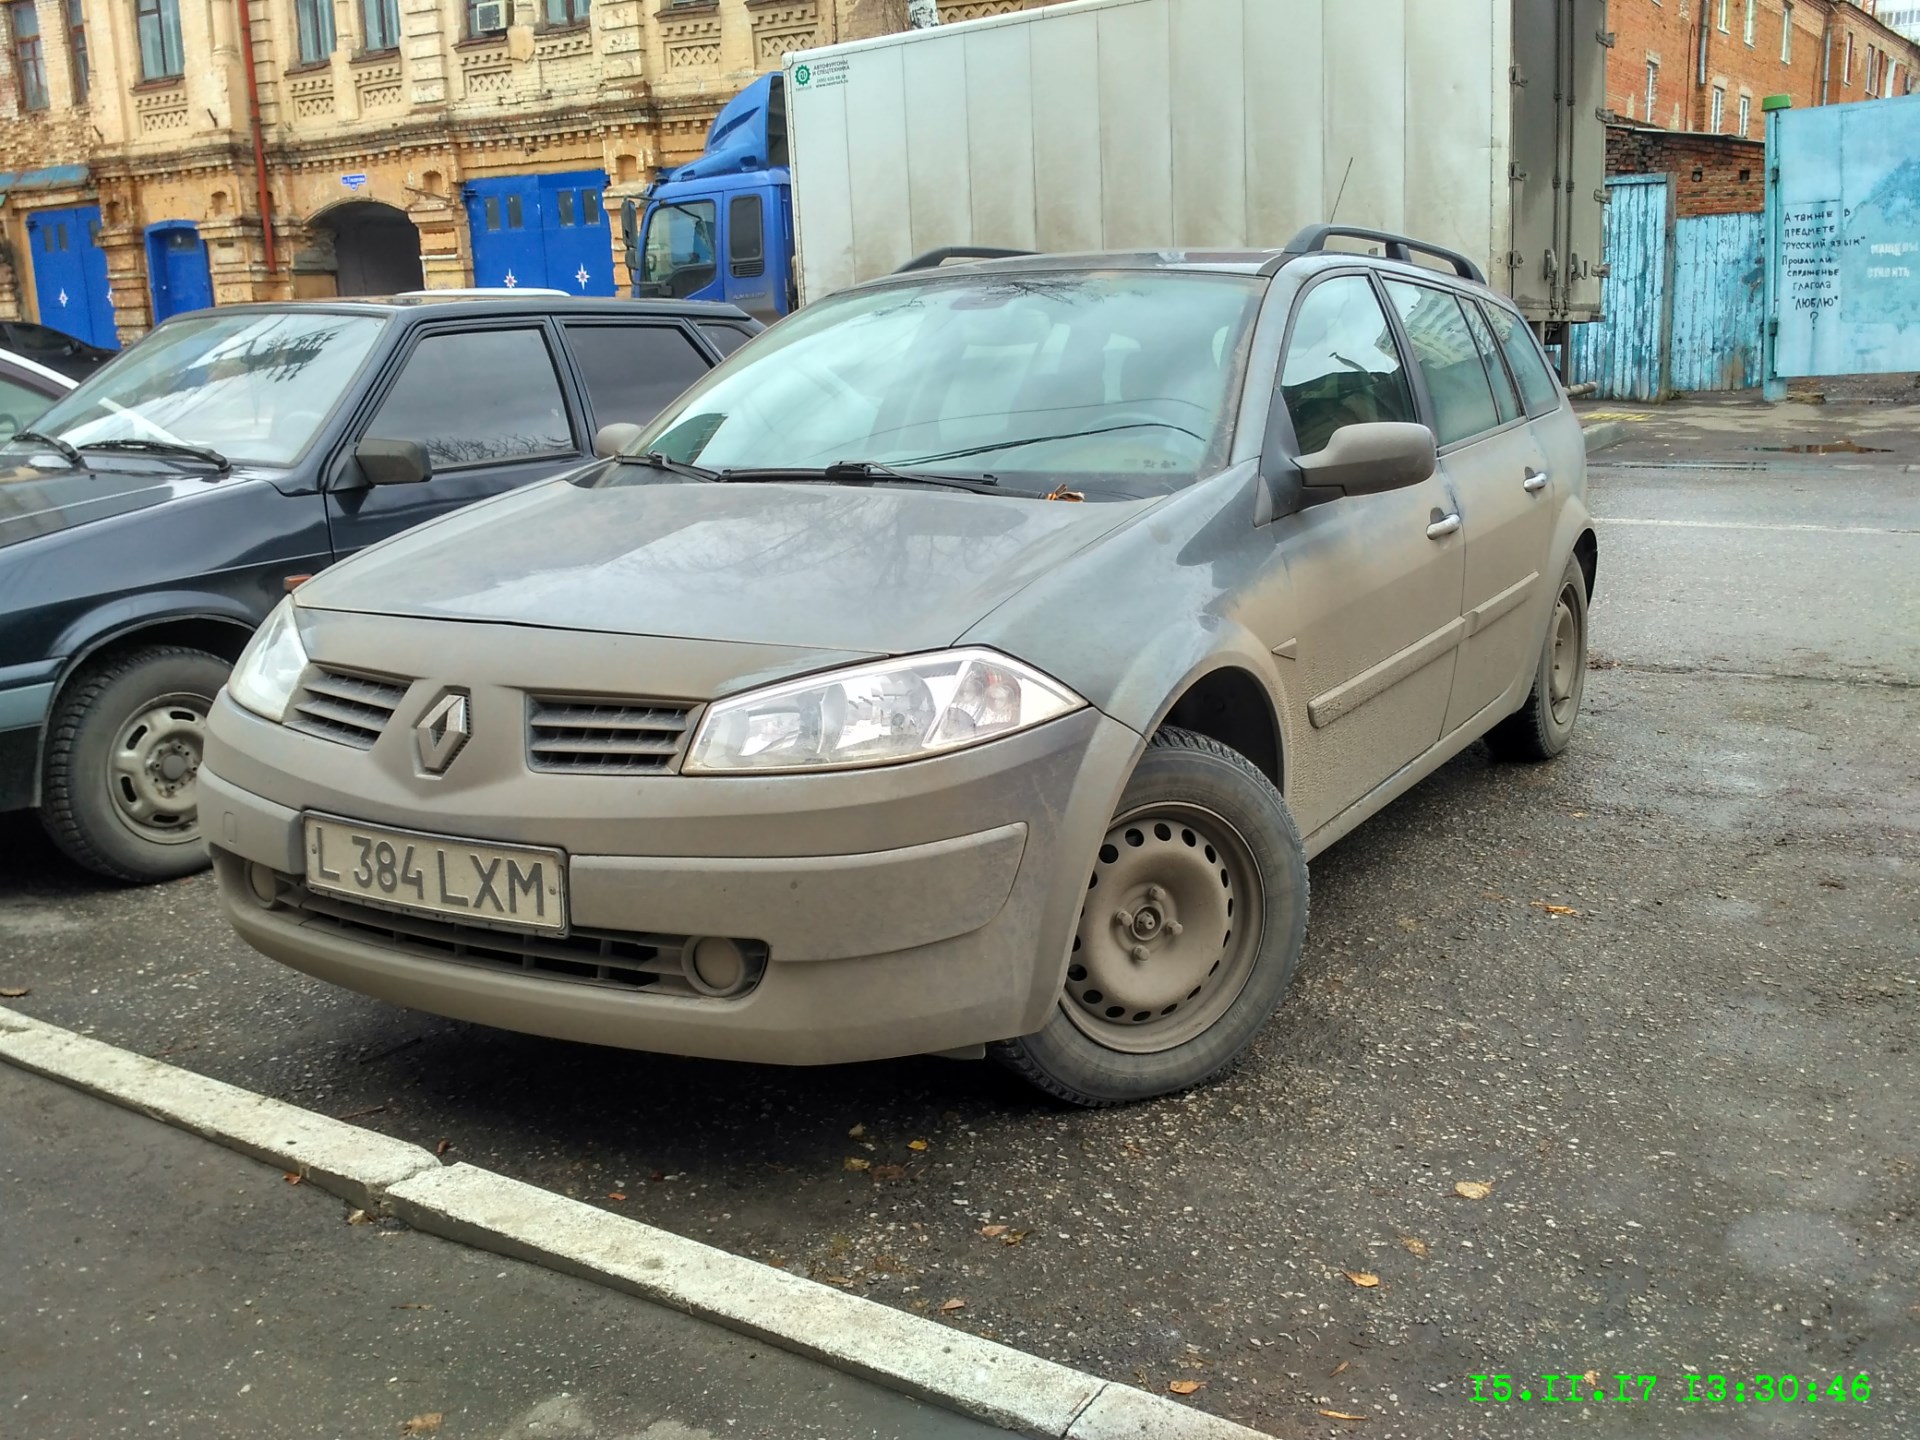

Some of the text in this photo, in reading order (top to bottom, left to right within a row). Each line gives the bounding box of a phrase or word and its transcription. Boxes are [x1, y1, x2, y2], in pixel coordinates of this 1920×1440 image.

[1784, 212, 1791, 224] А
[1784, 225, 1835, 238] ПРЕДМЕТЕ
[1810, 311, 1819, 330] ?
[316, 826, 545, 916] L 384 LXM
